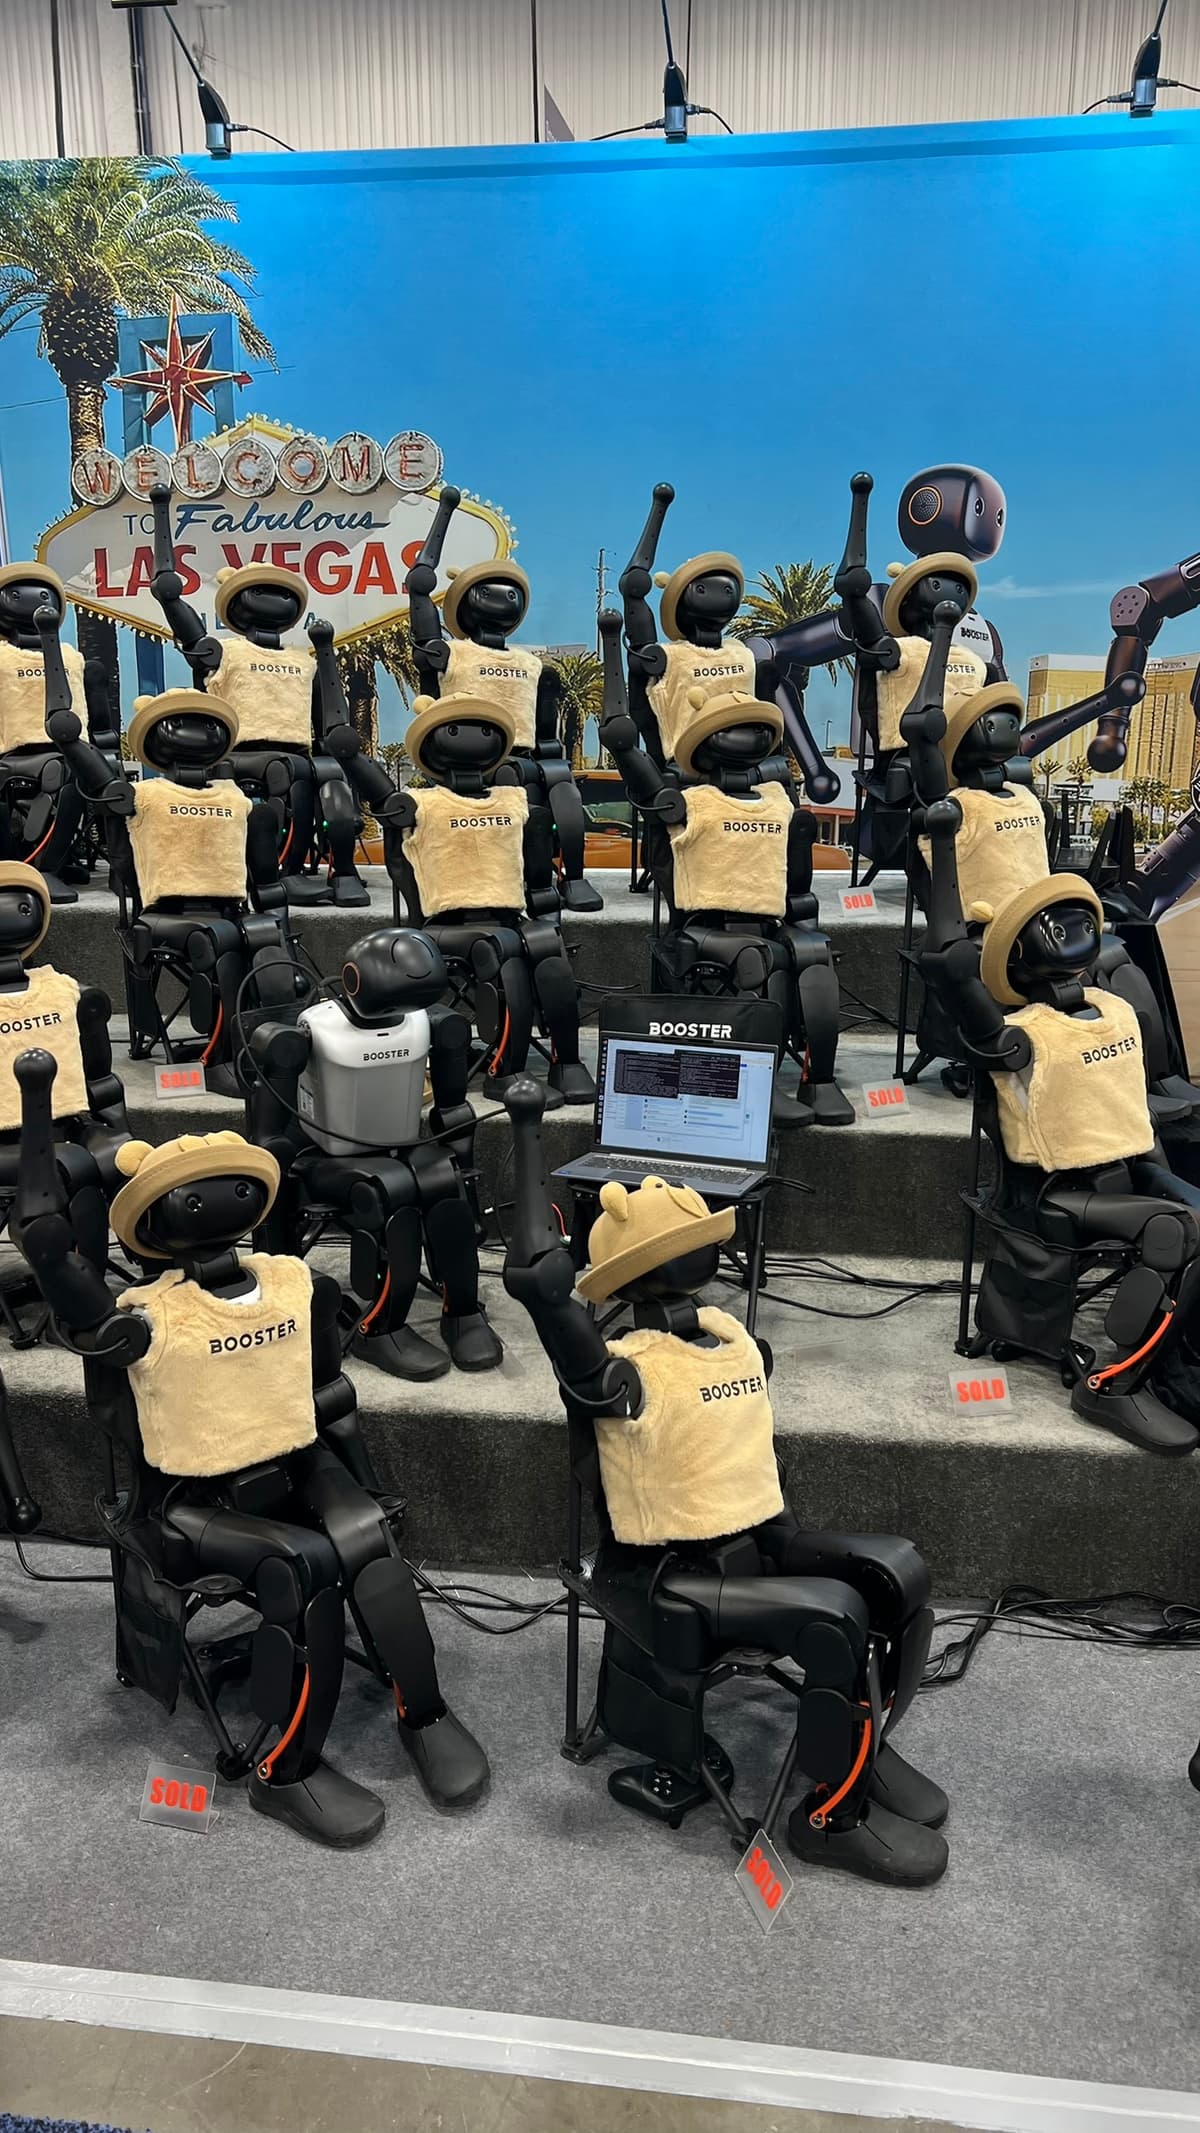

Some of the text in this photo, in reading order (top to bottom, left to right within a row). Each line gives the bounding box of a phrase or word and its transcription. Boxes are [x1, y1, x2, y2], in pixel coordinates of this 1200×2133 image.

[75, 443, 426, 495] WELCOME
[123, 500, 391, 540] TO Fabulous
[94, 544, 201, 598] LAS
[17, 668, 70, 677] BOOR
[250, 663, 302, 675] BOOSTER
[479, 667, 528, 678] BOOSTER
[694, 664, 745, 677] BOOSTER
[946, 664, 976, 674] OSTER
[170, 805, 232, 818] BOOSTER
[450, 816, 512, 828] BOOSTER
[723, 822, 782, 834] BOOSTER
[994, 815, 1041, 832] BOOSTER
[843, 894, 874, 909] SOLD
[0, 1012, 62, 1034] OOSTER
[649, 1022, 732, 1038] BOOSTER
[363, 1048, 409, 1061] BOOSTER
[1081, 1036, 1137, 1064] BOOSTER
[160, 1071, 201, 1088] SOLD
[870, 1087, 904, 1107] SOLD
[209, 1318, 297, 1354] BOOSTER
[699, 1376, 763, 1402] BOOSTER
[956, 1377, 1005, 1402] SOLD
[150, 1777, 208, 1812] SOLD
[746, 1846, 783, 1909] SOLD
